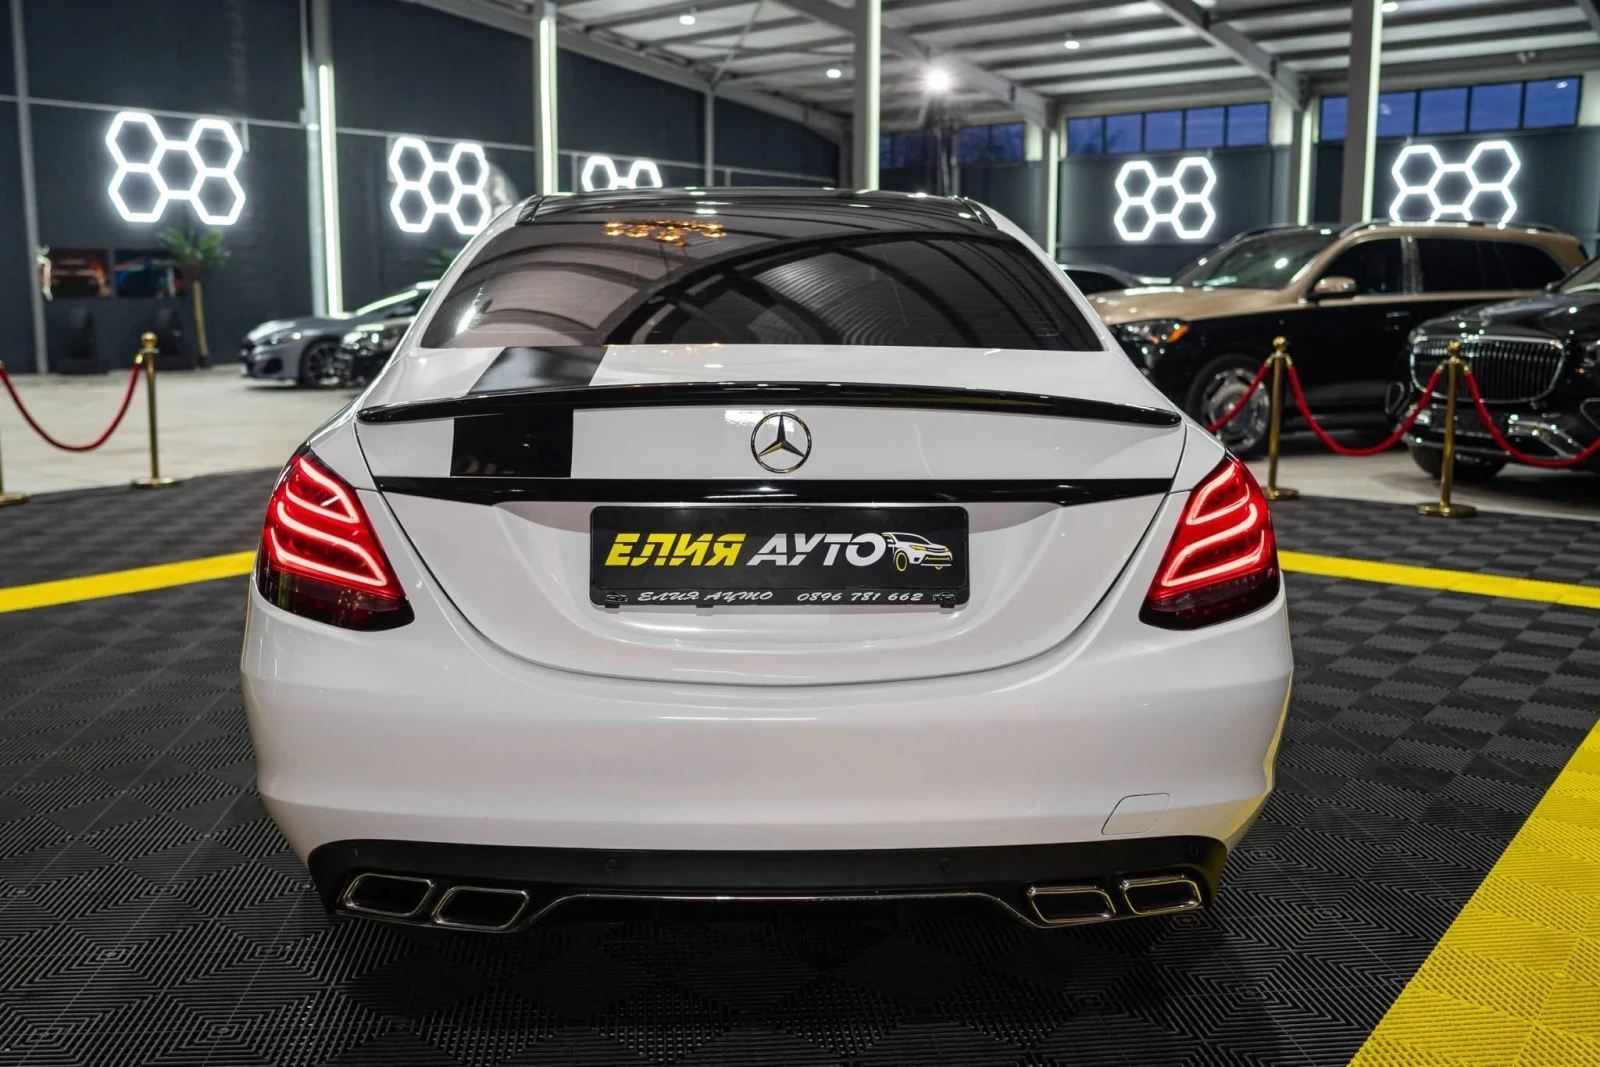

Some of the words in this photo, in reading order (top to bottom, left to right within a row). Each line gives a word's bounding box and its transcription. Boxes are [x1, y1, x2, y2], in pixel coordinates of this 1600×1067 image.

[604, 533, 746, 567] ЕЛИЯ
[747, 532, 886, 566] АУТО
[796, 592, 843, 602] 0896
[850, 592, 882, 602] 781
[887, 592, 924, 602] 662
